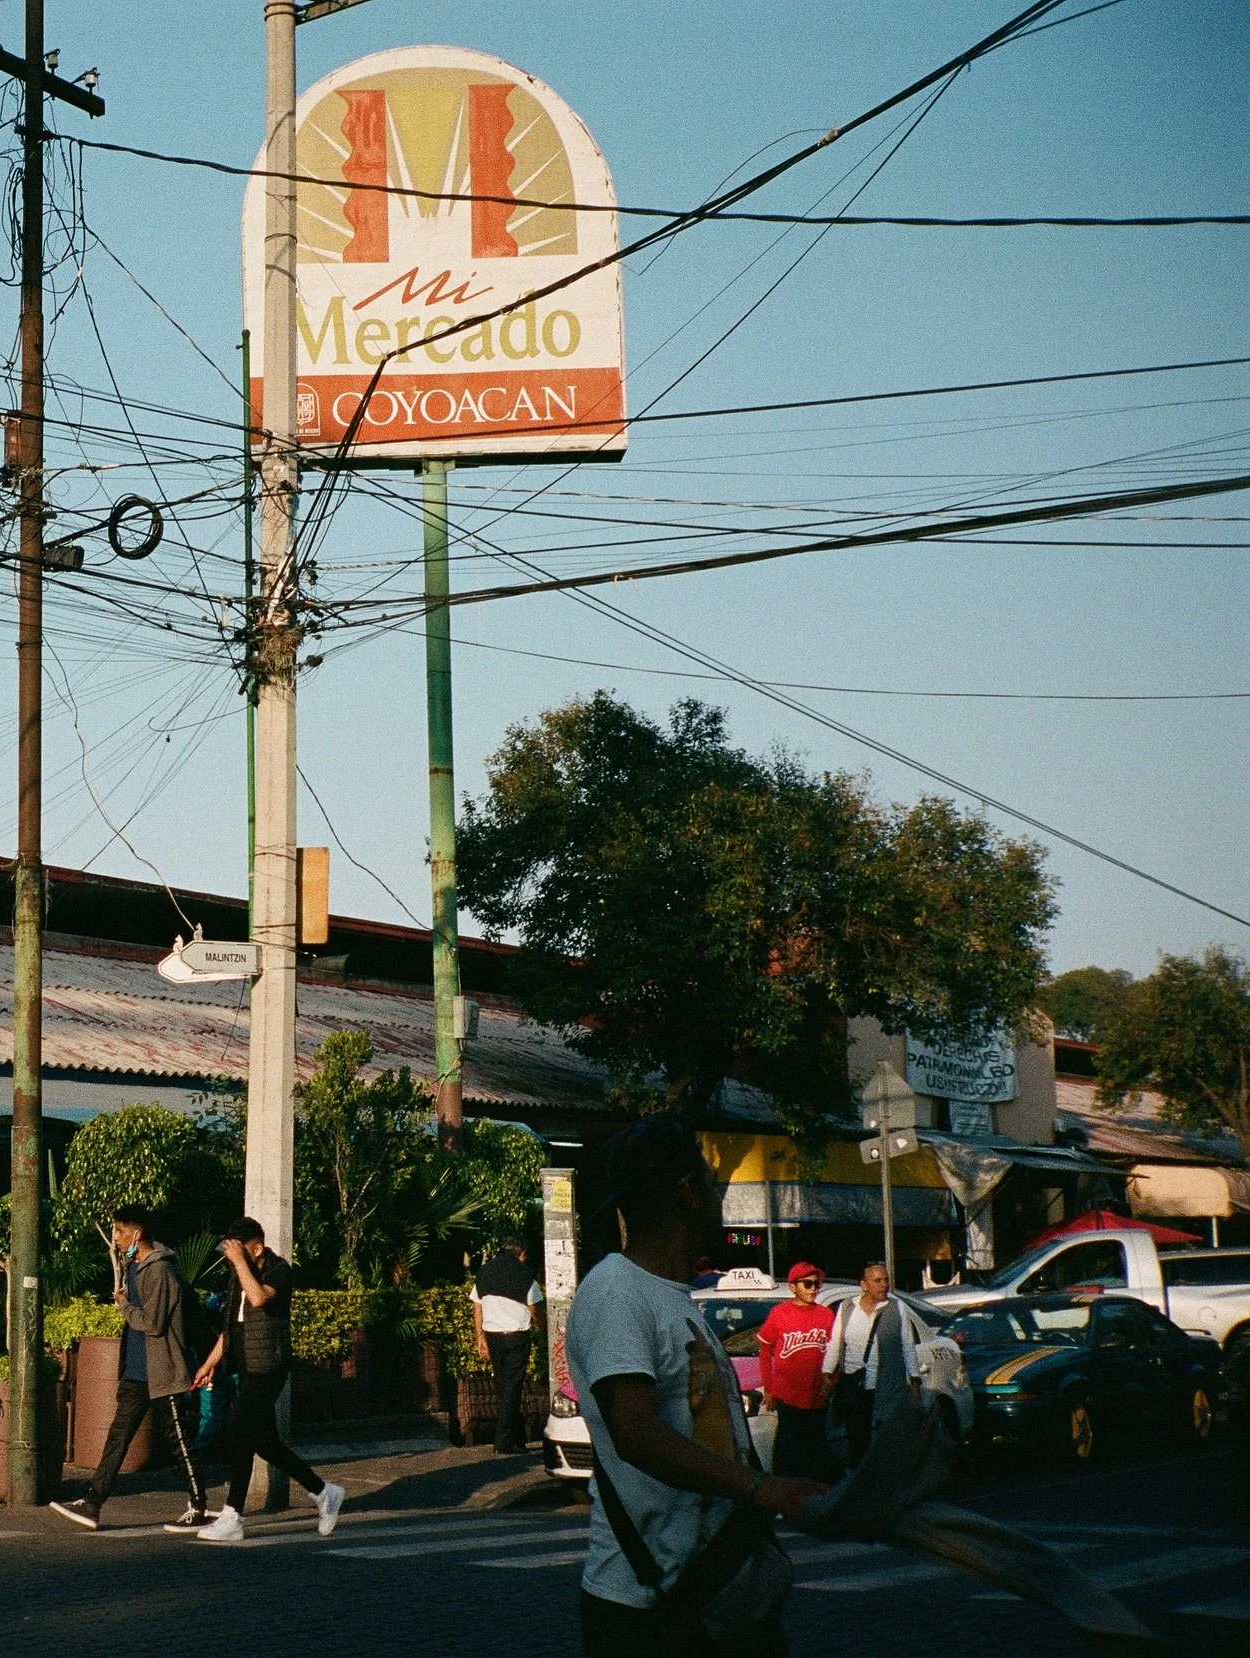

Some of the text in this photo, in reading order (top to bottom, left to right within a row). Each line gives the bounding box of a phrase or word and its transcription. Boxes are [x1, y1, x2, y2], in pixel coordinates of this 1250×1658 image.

[353, 267, 494, 311] Mi
[296, 288, 581, 365] Mercado
[332, 386, 577, 426] COYOACAN
[205, 952, 246, 963] MALINTZIN
[732, 1270, 755, 1280] TAXI
